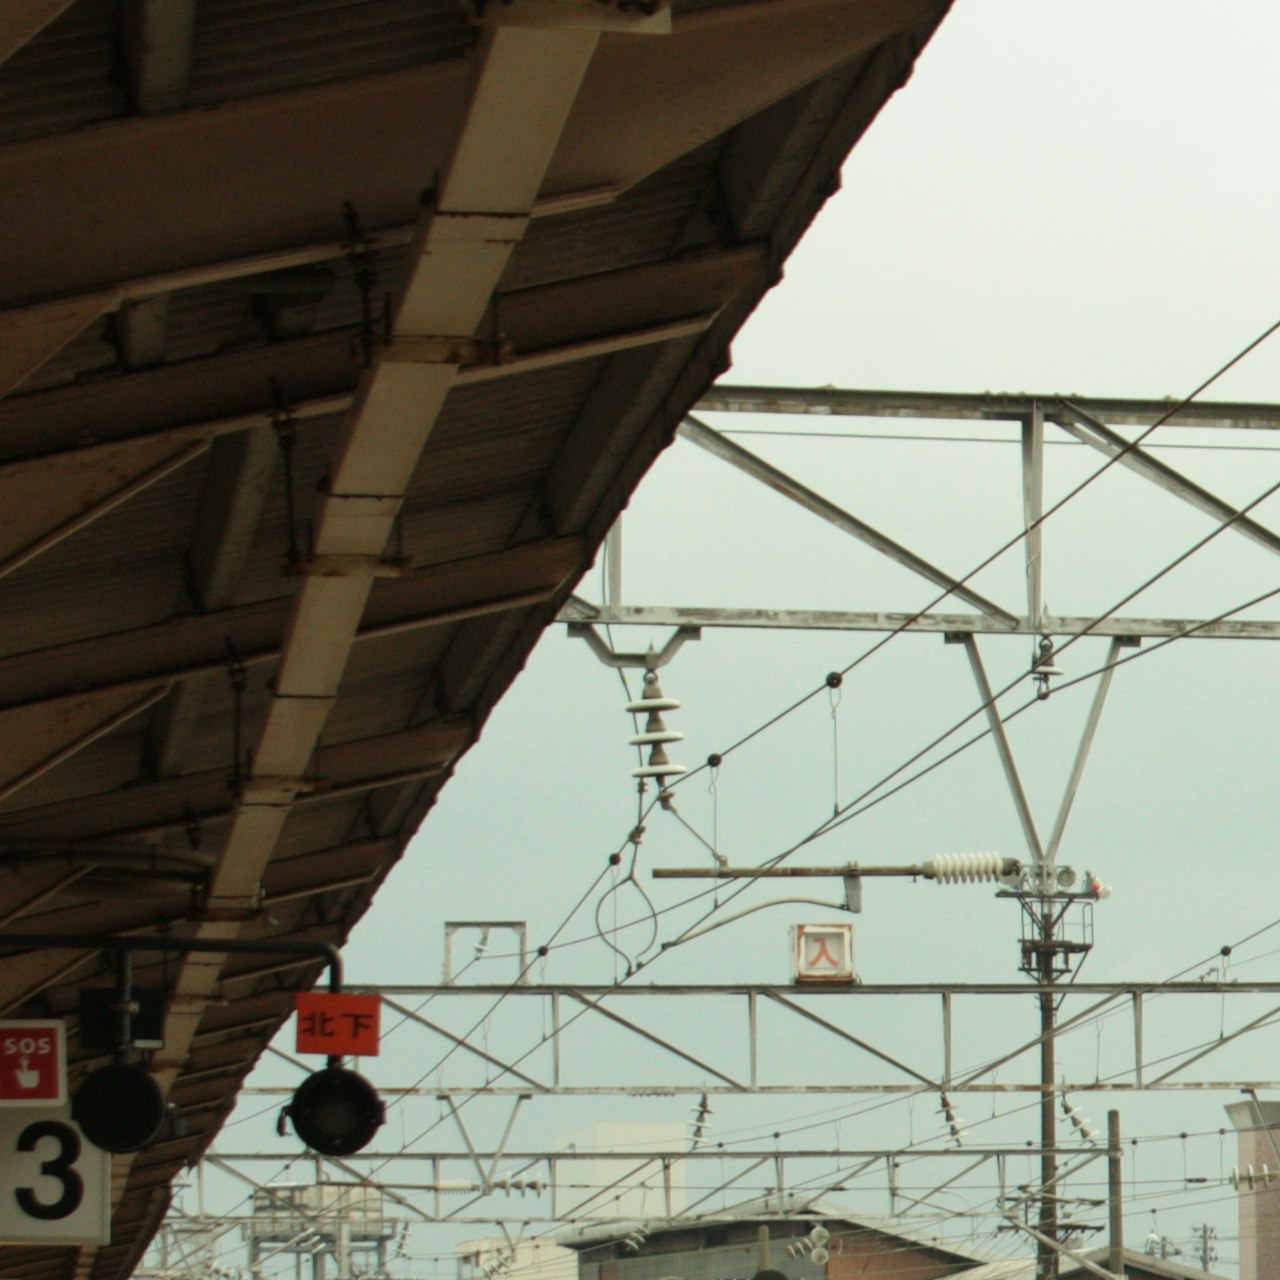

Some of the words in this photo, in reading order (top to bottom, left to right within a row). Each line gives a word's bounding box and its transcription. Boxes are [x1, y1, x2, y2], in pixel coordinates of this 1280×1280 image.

[808, 936, 839, 968] 入
[302, 1010, 375, 1037] 北下
[4, 1037, 51, 1054] SOS
[14, 1120, 85, 1220] 3
